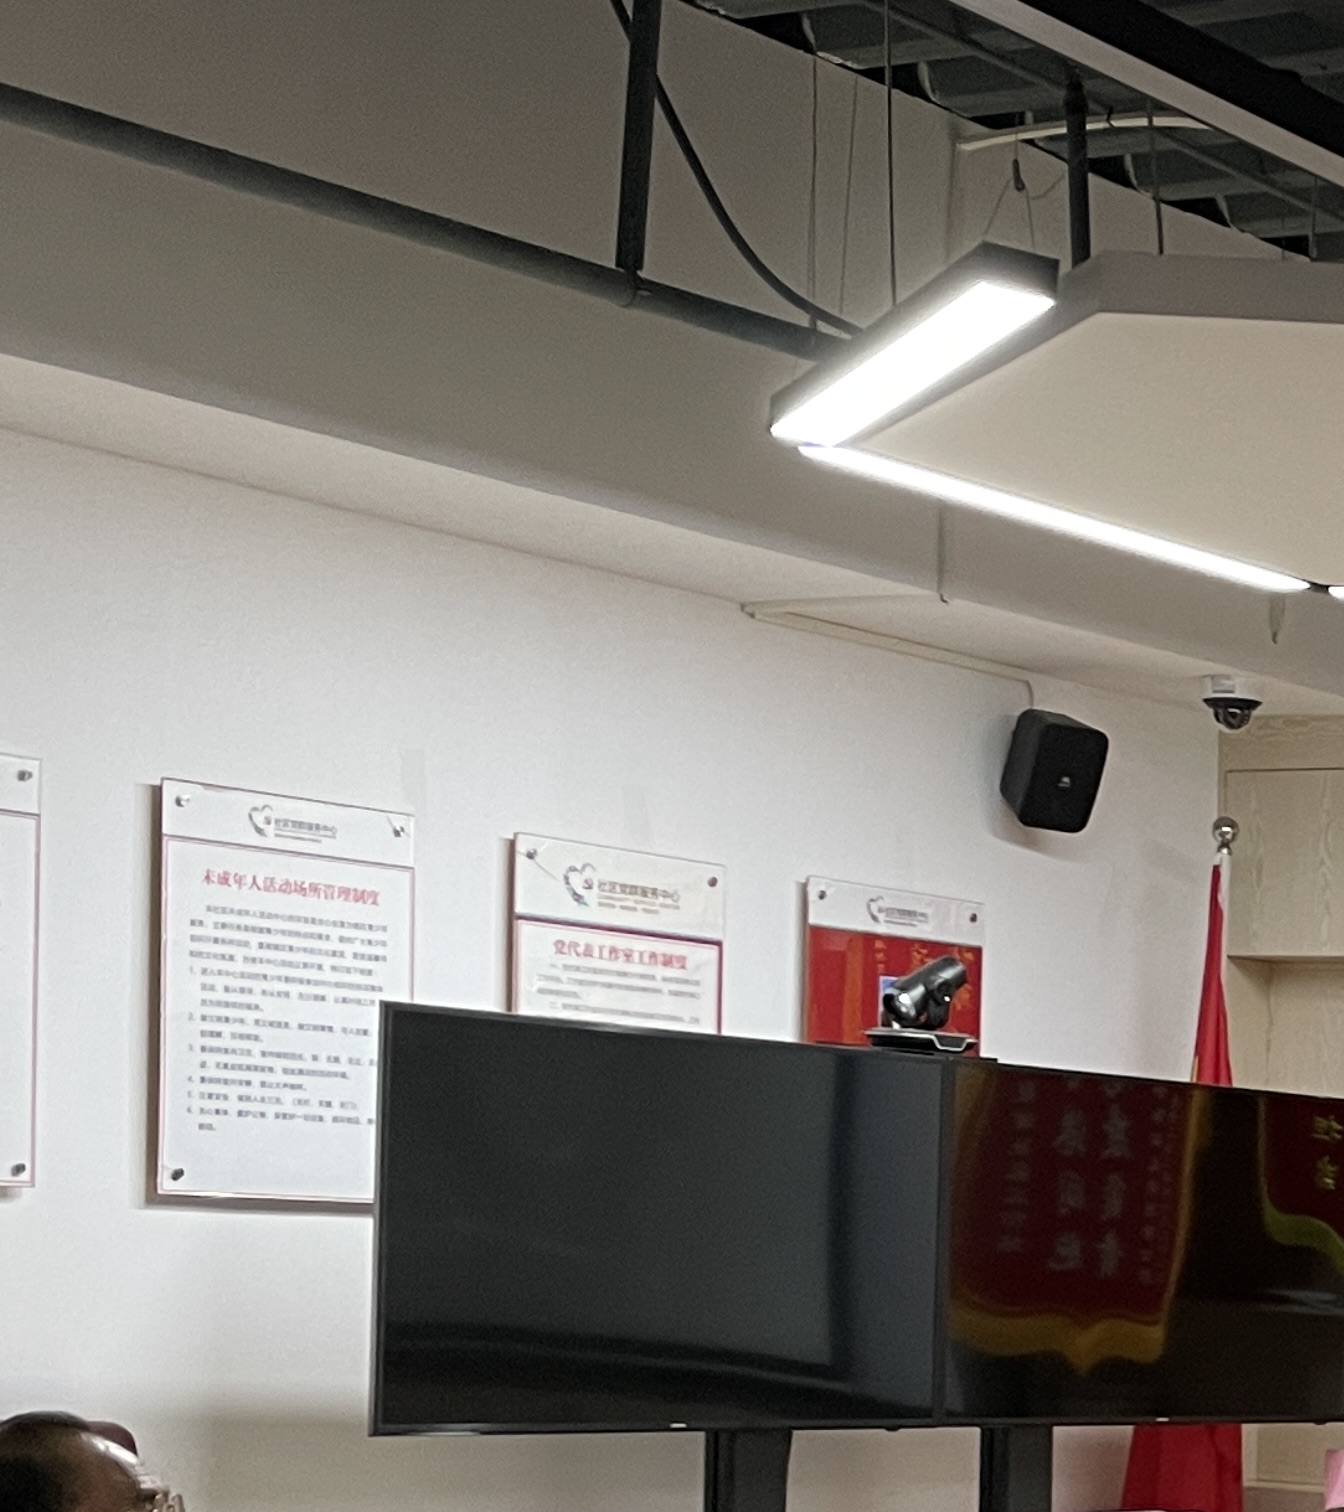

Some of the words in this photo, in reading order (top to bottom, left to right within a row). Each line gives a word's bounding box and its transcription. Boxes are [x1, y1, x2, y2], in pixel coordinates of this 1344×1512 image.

[202, 868, 381, 907] 未成年人活动场所管理制度
[553, 938, 689, 971] 党代表工作室工作制度
